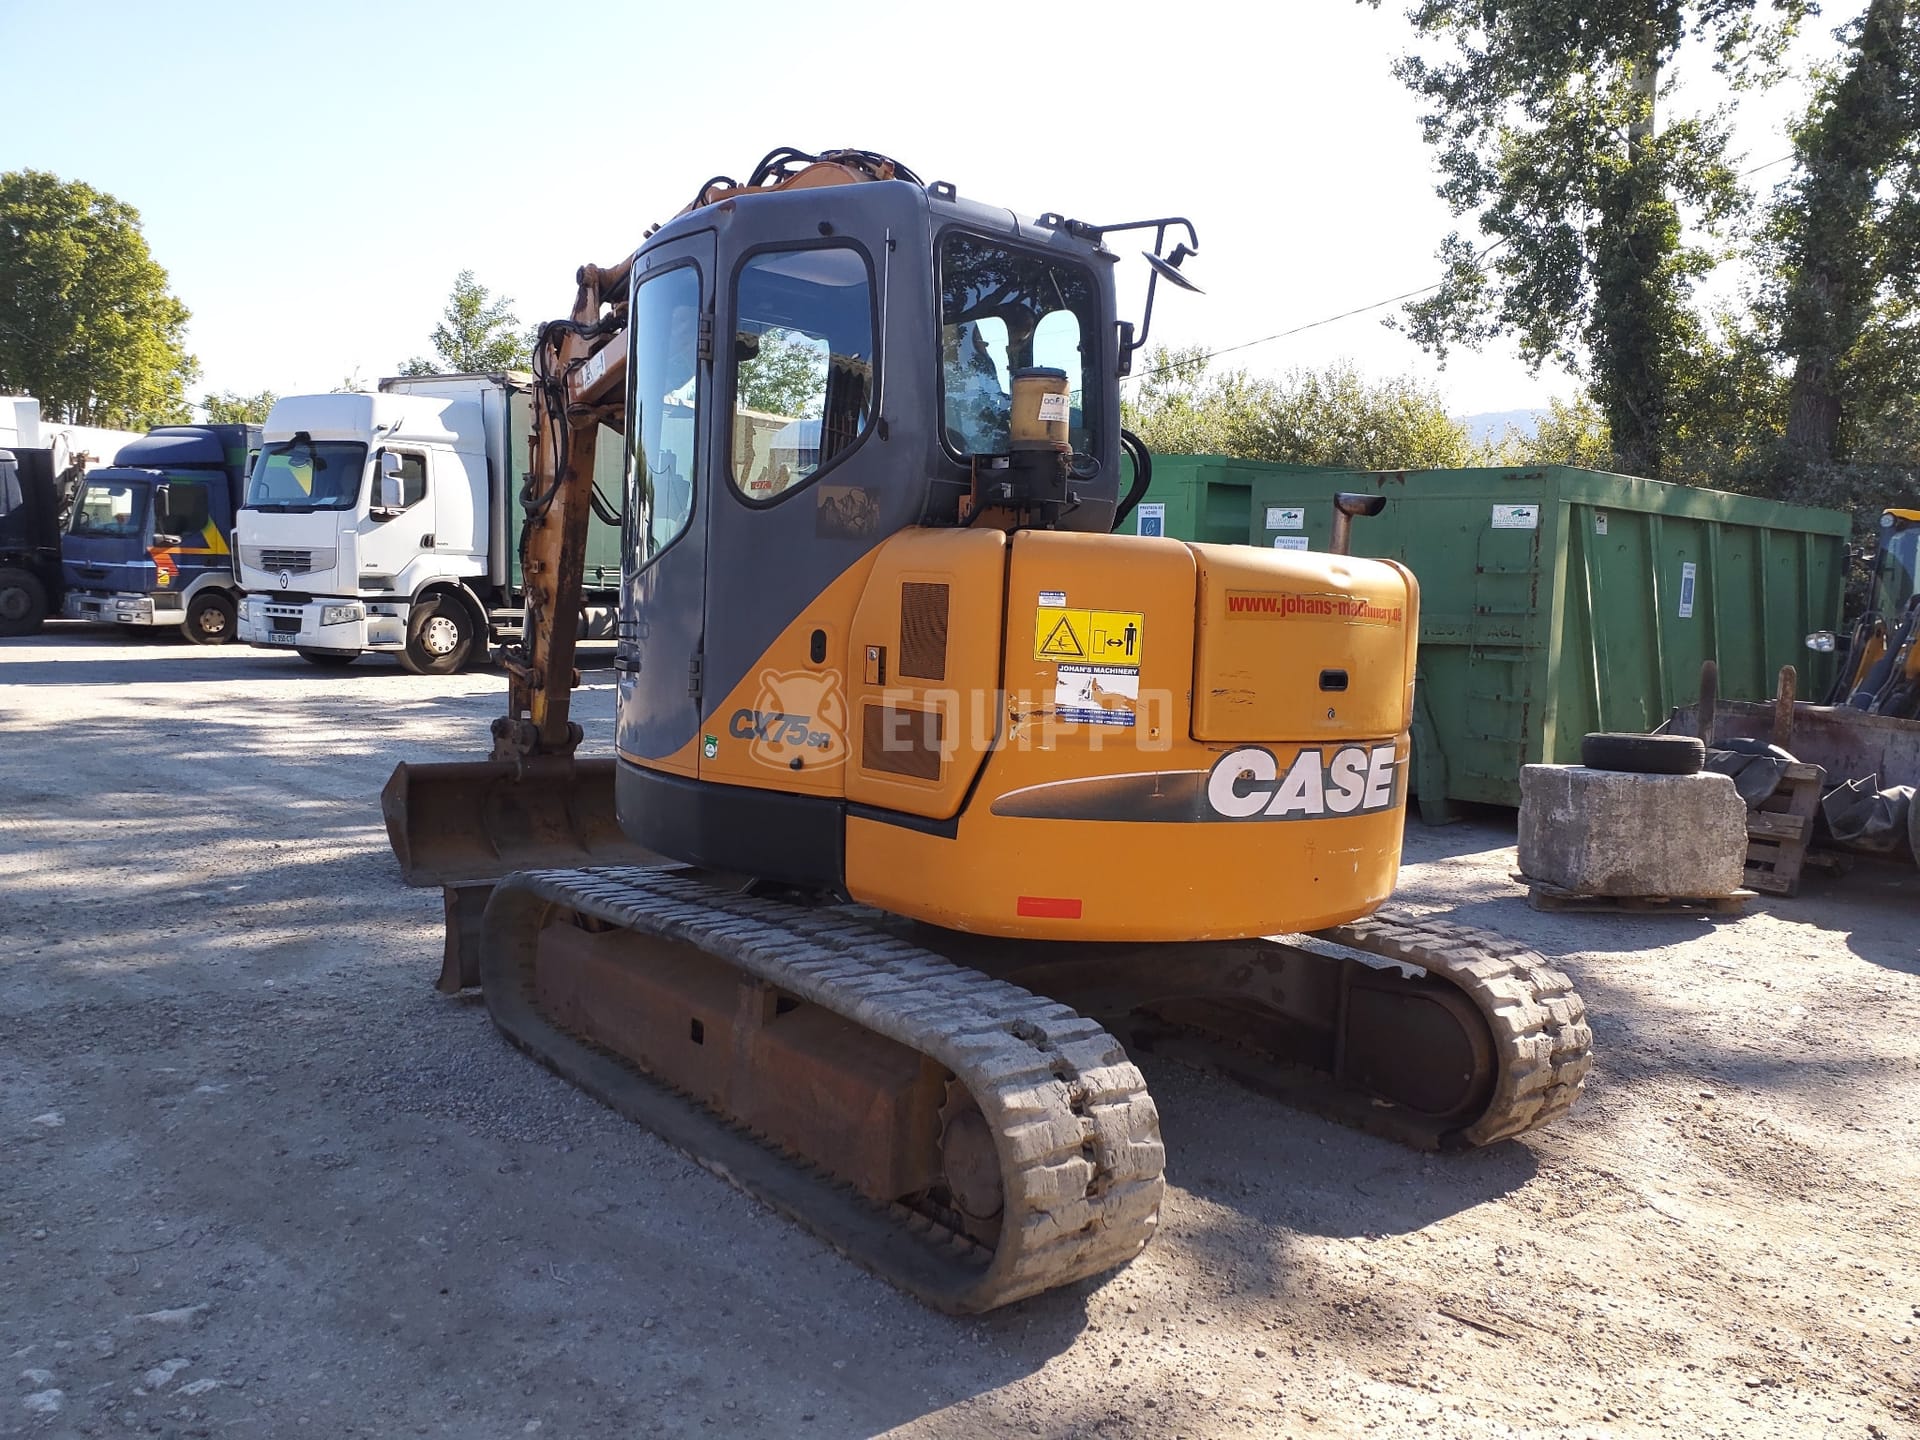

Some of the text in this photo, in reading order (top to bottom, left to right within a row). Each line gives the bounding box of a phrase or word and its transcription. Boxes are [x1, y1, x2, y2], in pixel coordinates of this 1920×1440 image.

[1059, 665, 1138, 676] JOHAN'S MACHINERY
[1207, 744, 1397, 819] CASE
